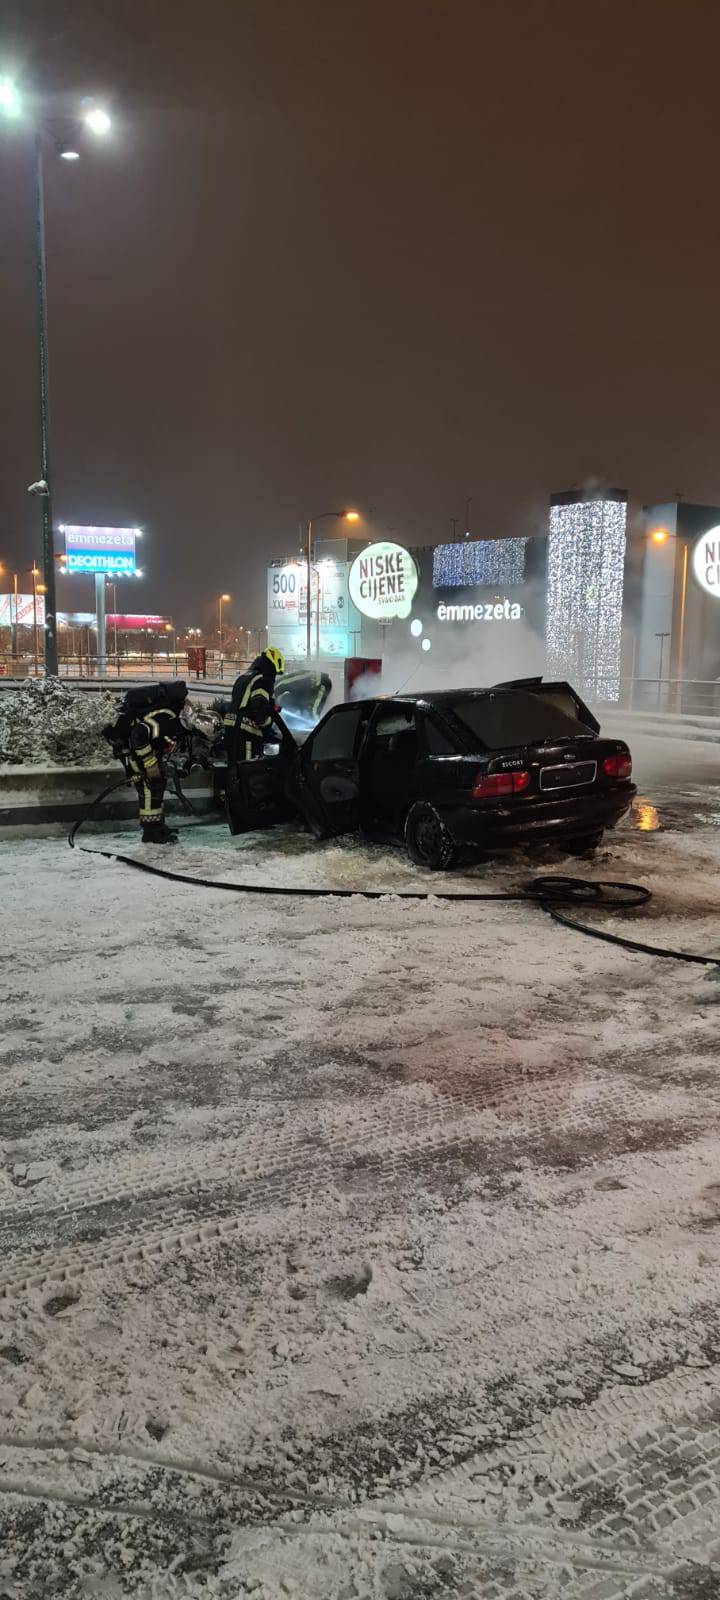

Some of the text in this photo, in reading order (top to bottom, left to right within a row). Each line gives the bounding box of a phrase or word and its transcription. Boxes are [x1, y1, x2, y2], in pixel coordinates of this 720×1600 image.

[68, 555, 134, 569] DECATHLON
[359, 552, 404, 579] NISKE
[272, 574, 296, 594] 500
[359, 574, 405, 600] CIJENE
[272, 600, 285, 609] XXL
